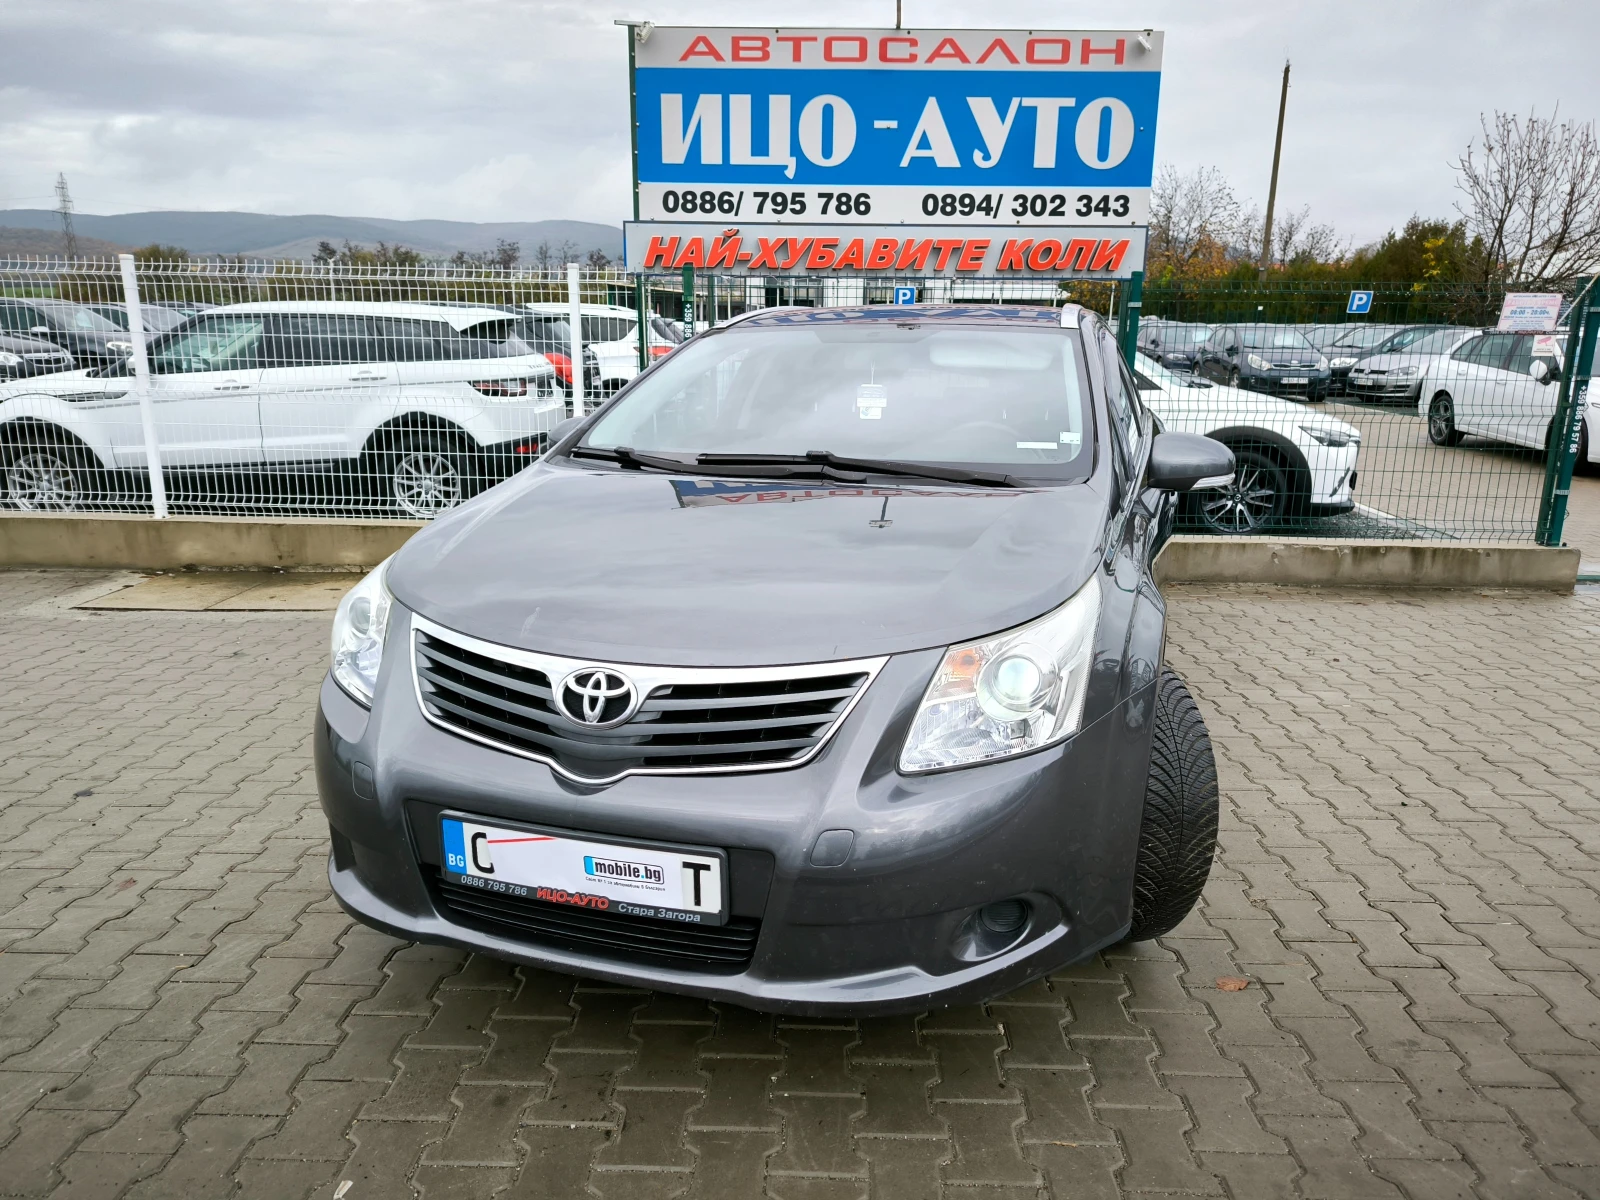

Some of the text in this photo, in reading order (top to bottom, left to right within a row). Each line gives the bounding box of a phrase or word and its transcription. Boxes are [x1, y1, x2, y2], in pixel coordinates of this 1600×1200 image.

[678, 35, 1126, 65] АВТОСАЛОН
[661, 190, 872, 216] 0886/ 795 786
[921, 192, 1131, 219] 0894/ 302 343
[643, 228, 1132, 271] НАЙ-ХУБАВИТЕ КОЛИ
[898, 289, 911, 305] P
[1351, 293, 1368, 311] P
[684, 303, 693, 338] +359 886
[1575, 406, 1584, 420] 886
[1572, 421, 1582, 431] 79
[1571, 433, 1580, 442] 57
[1569, 444, 1578, 454] 86
[448, 853, 465, 868] BG
[682, 861, 711, 907] T
[594, 861, 662, 882] mobile.bg
[460, 875, 528, 896] 0886 795 786
[536, 887, 610, 910] ИЦО-АУТО
[618, 903, 701, 922] Стара Загора
